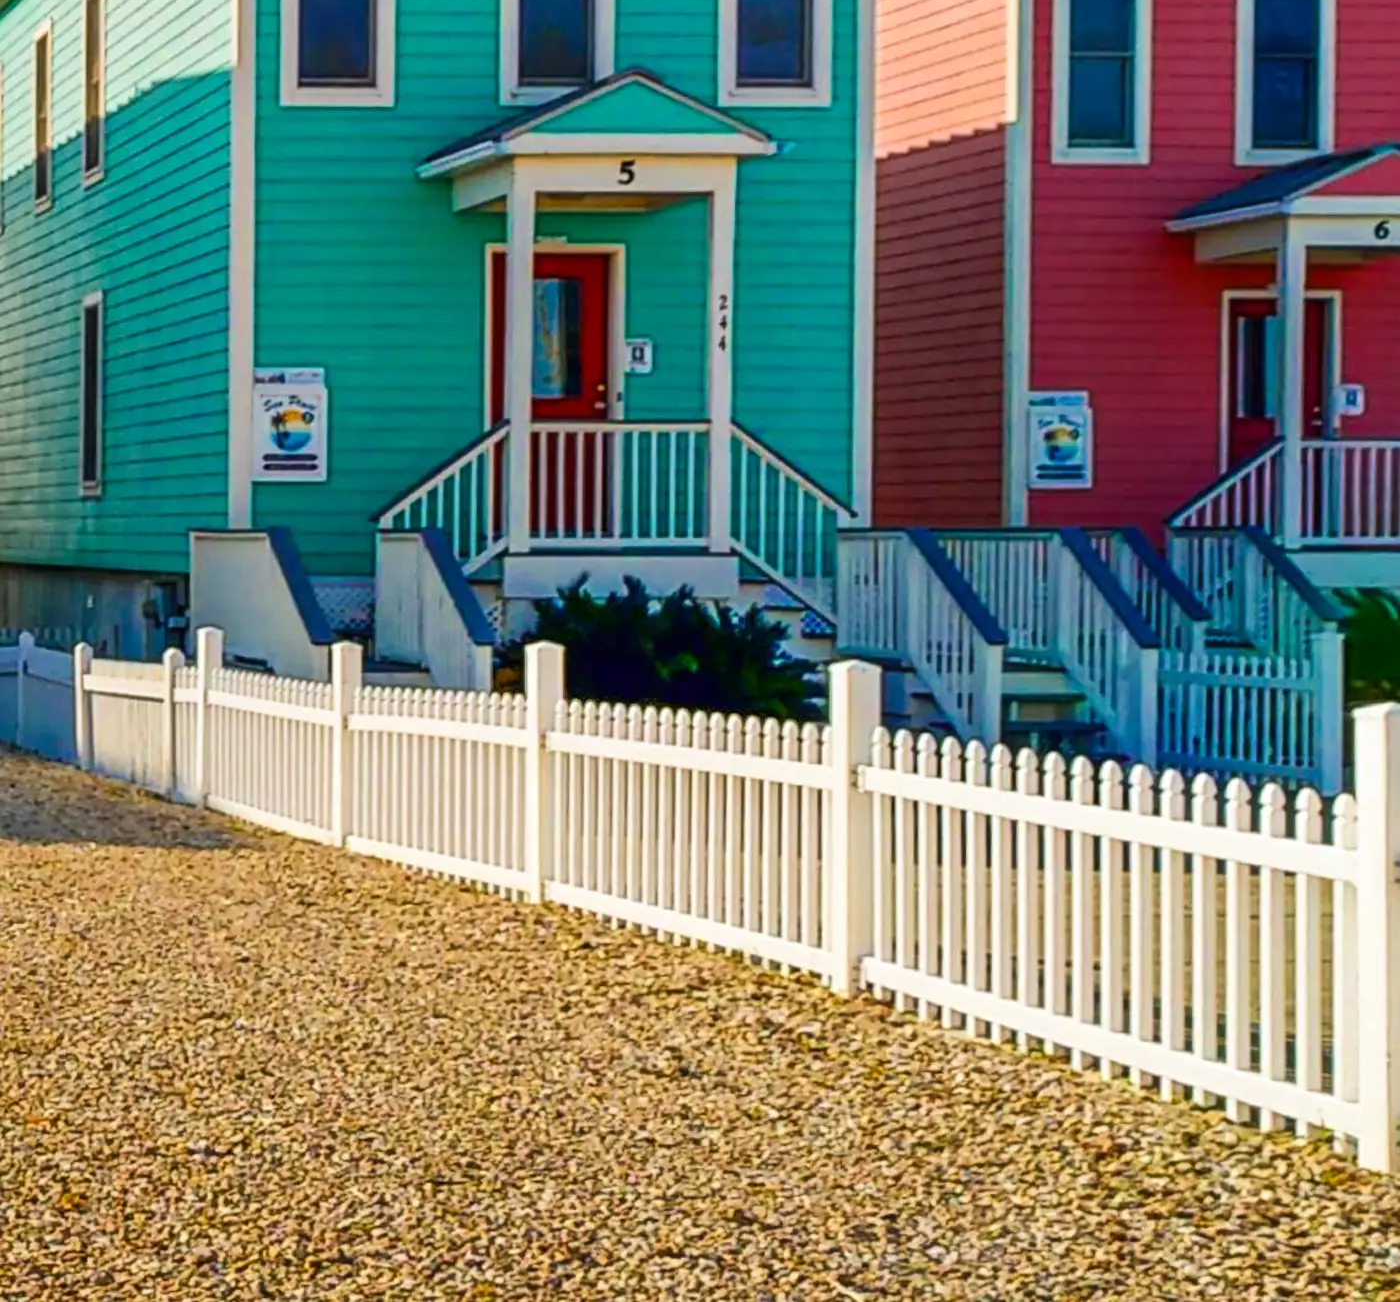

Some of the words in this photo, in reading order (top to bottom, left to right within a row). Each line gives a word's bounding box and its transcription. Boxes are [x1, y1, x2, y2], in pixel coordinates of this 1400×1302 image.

[617, 159, 636, 185] 5
[1374, 219, 1390, 240] 6
[718, 294, 728, 351] 244
